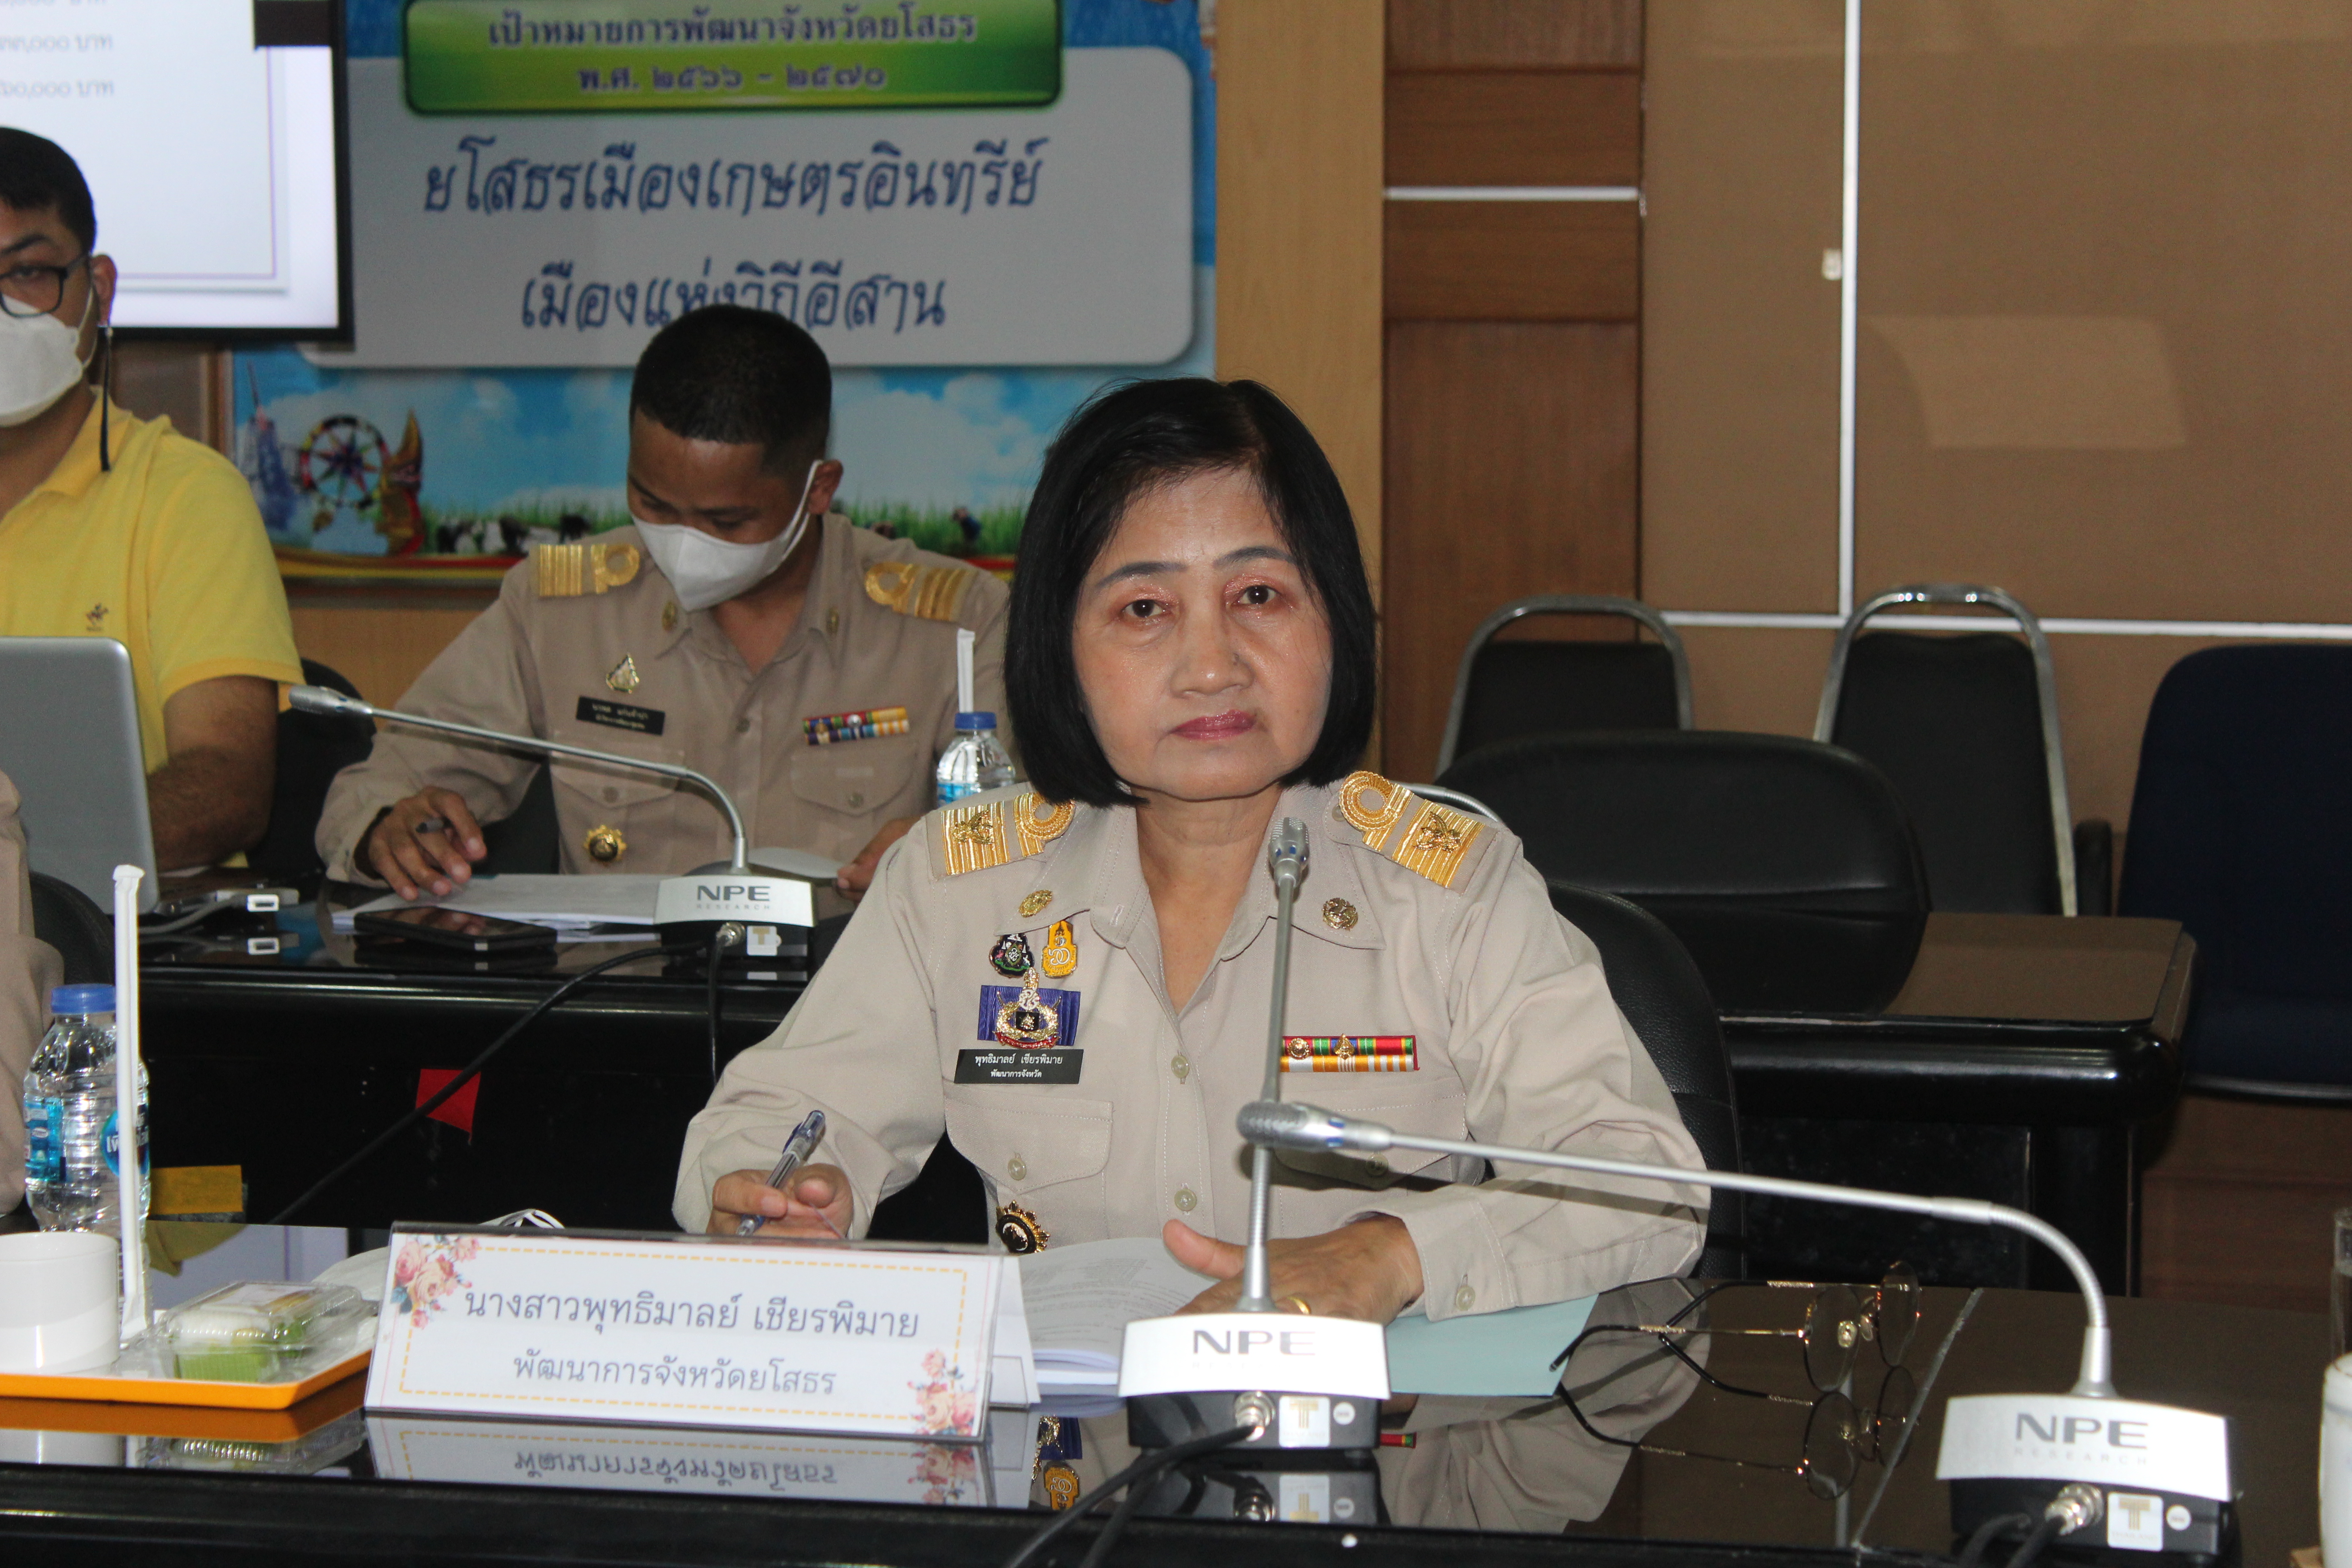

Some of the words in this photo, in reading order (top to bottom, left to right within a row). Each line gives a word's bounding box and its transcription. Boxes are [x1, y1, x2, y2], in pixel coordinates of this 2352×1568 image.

[489, 1, 976, 45] เป้าหมายการพัฒนาจังหวัดยโสธร
[74, 33, 113, 52] บาท
[76, 78, 114, 97] บาท
[578, 68, 640, 90] พ.ศ.
[652, 64, 743, 89] ๒๕๖๖
[786, 64, 885, 88] ๒๕๗๐
[424, 136, 1049, 216] ยโสธรเมืองเกษตรอินทรีย์
[697, 886, 770, 901] NPE
[975, 1053, 1016, 1067] พุทธิมาลย์
[990, 1068, 1042, 1078] พัฒนาการจังหวัด
[465, 1290, 743, 1334] นางสาวพุทธิมาลย์
[754, 1296, 919, 1338] เชียรพิมาย
[1193, 1330, 1316, 1356] NPE
[514, 1348, 837, 1395] พัฒนาการจังหวัดยโสธร
[2016, 1413, 2149, 1450] NPE
